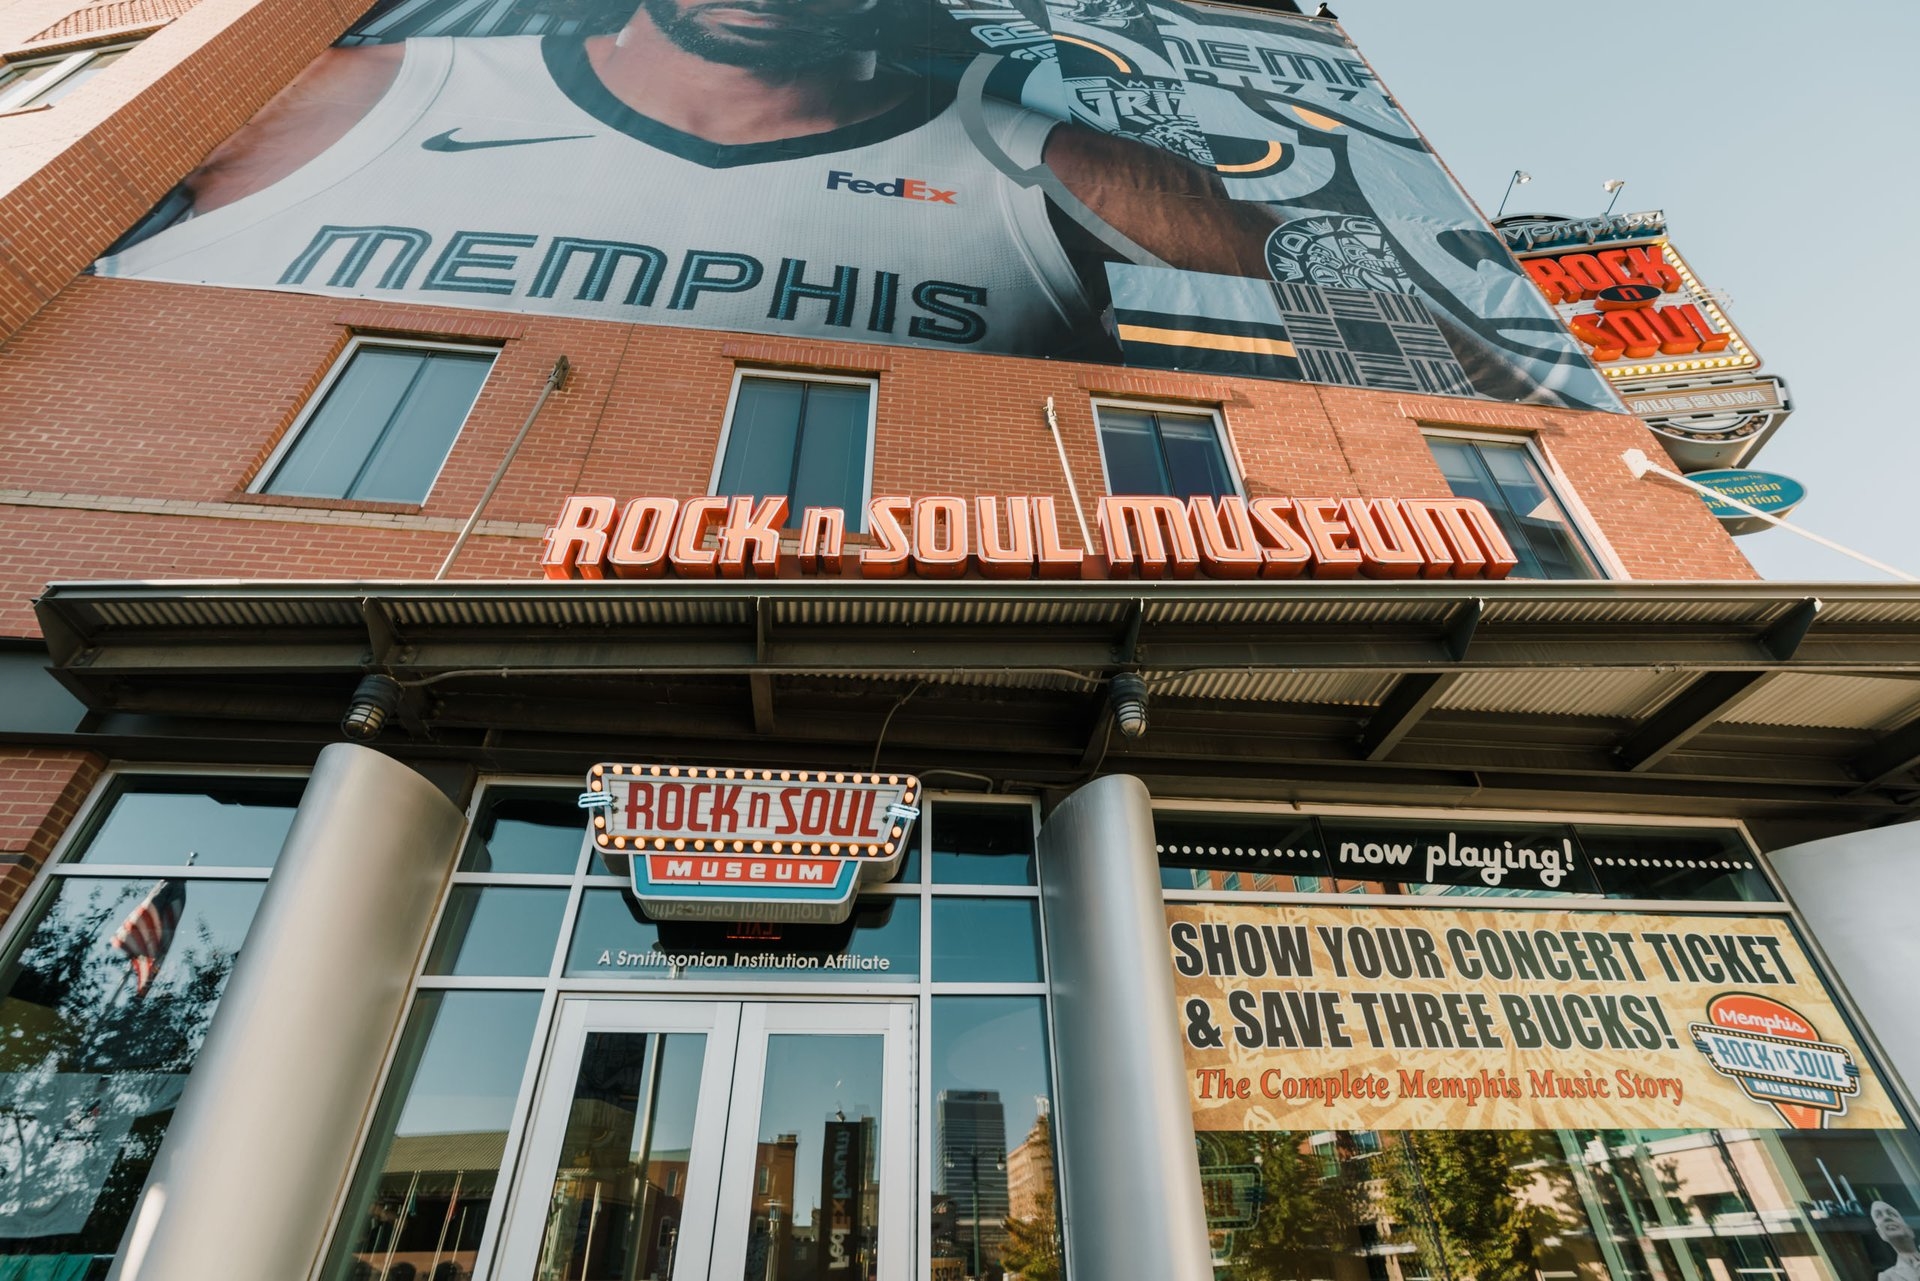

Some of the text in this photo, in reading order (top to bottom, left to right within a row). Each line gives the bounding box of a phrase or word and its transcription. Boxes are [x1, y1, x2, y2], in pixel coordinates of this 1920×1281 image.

[827, 170, 958, 205] FedEx
[278, 224, 987, 345] MEMPHIS
[1521, 245, 1682, 304] ROCK
[1571, 304, 1730, 361] SOUL
[541, 495, 1518, 579] ROCK n SOUL MUSEUM
[625, 782, 880, 837] ROCK n SOUL
[1340, 832, 1575, 888] now playing!
[597, 949, 890, 971] A Smithsonian Institution Affiliate
[1170, 921, 1798, 985] SHOW YOUR CONCERT TICKET
[1184, 990, 1681, 1050] & SAVE THREE BUCKS!
[1718, 1008, 1808, 1035] Memphis
[1712, 1037, 1843, 1082] ROCK n SOUL
[1196, 1069, 1684, 1107] The Complete Memphis Music Story
